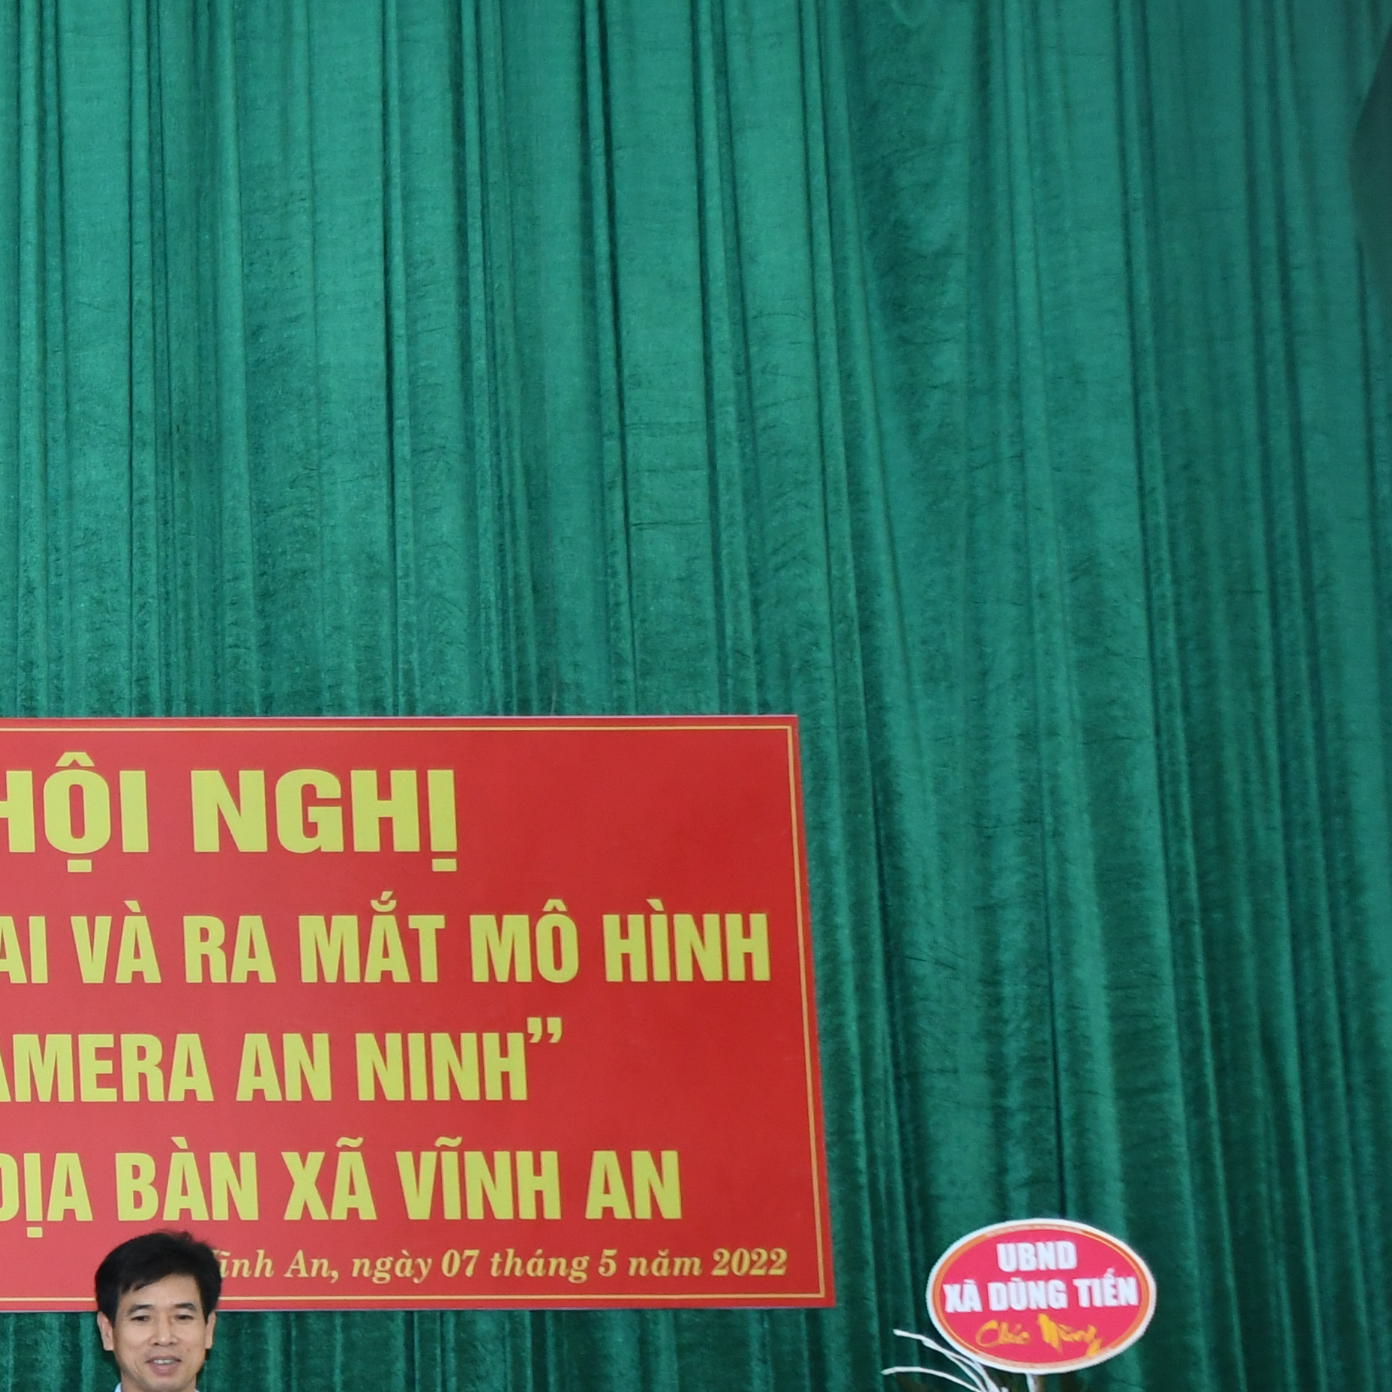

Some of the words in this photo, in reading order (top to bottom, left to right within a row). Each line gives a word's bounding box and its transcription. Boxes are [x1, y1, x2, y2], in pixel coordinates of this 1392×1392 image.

[191, 768, 458, 872] NGHỊ
[71, 900, 162, 984] VÀ
[183, 915, 277, 983] RA
[298, 891, 446, 983] MẮT
[469, 899, 579, 983] MÔ
[603, 898, 770, 982] HÌNH
[236, 1033, 332, 1102] AN
[116, 1136, 259, 1222] BÀN
[281, 1137, 377, 1221] XÃ
[396, 1136, 561, 1220] VĨNH
[585, 1150, 682, 1219] AN
[284, 1249, 340, 1284] An,
[352, 1249, 433, 1284] ngày
[441, 1248, 480, 1277] 07
[490, 1248, 590, 1284] tháng
[598, 1249, 618, 1276] 5
[628, 1248, 703, 1277] năm
[711, 1248, 789, 1277] 2022
[996, 1240, 1077, 1272] UBND
[1073, 1267, 1139, 1308] TIẾN
